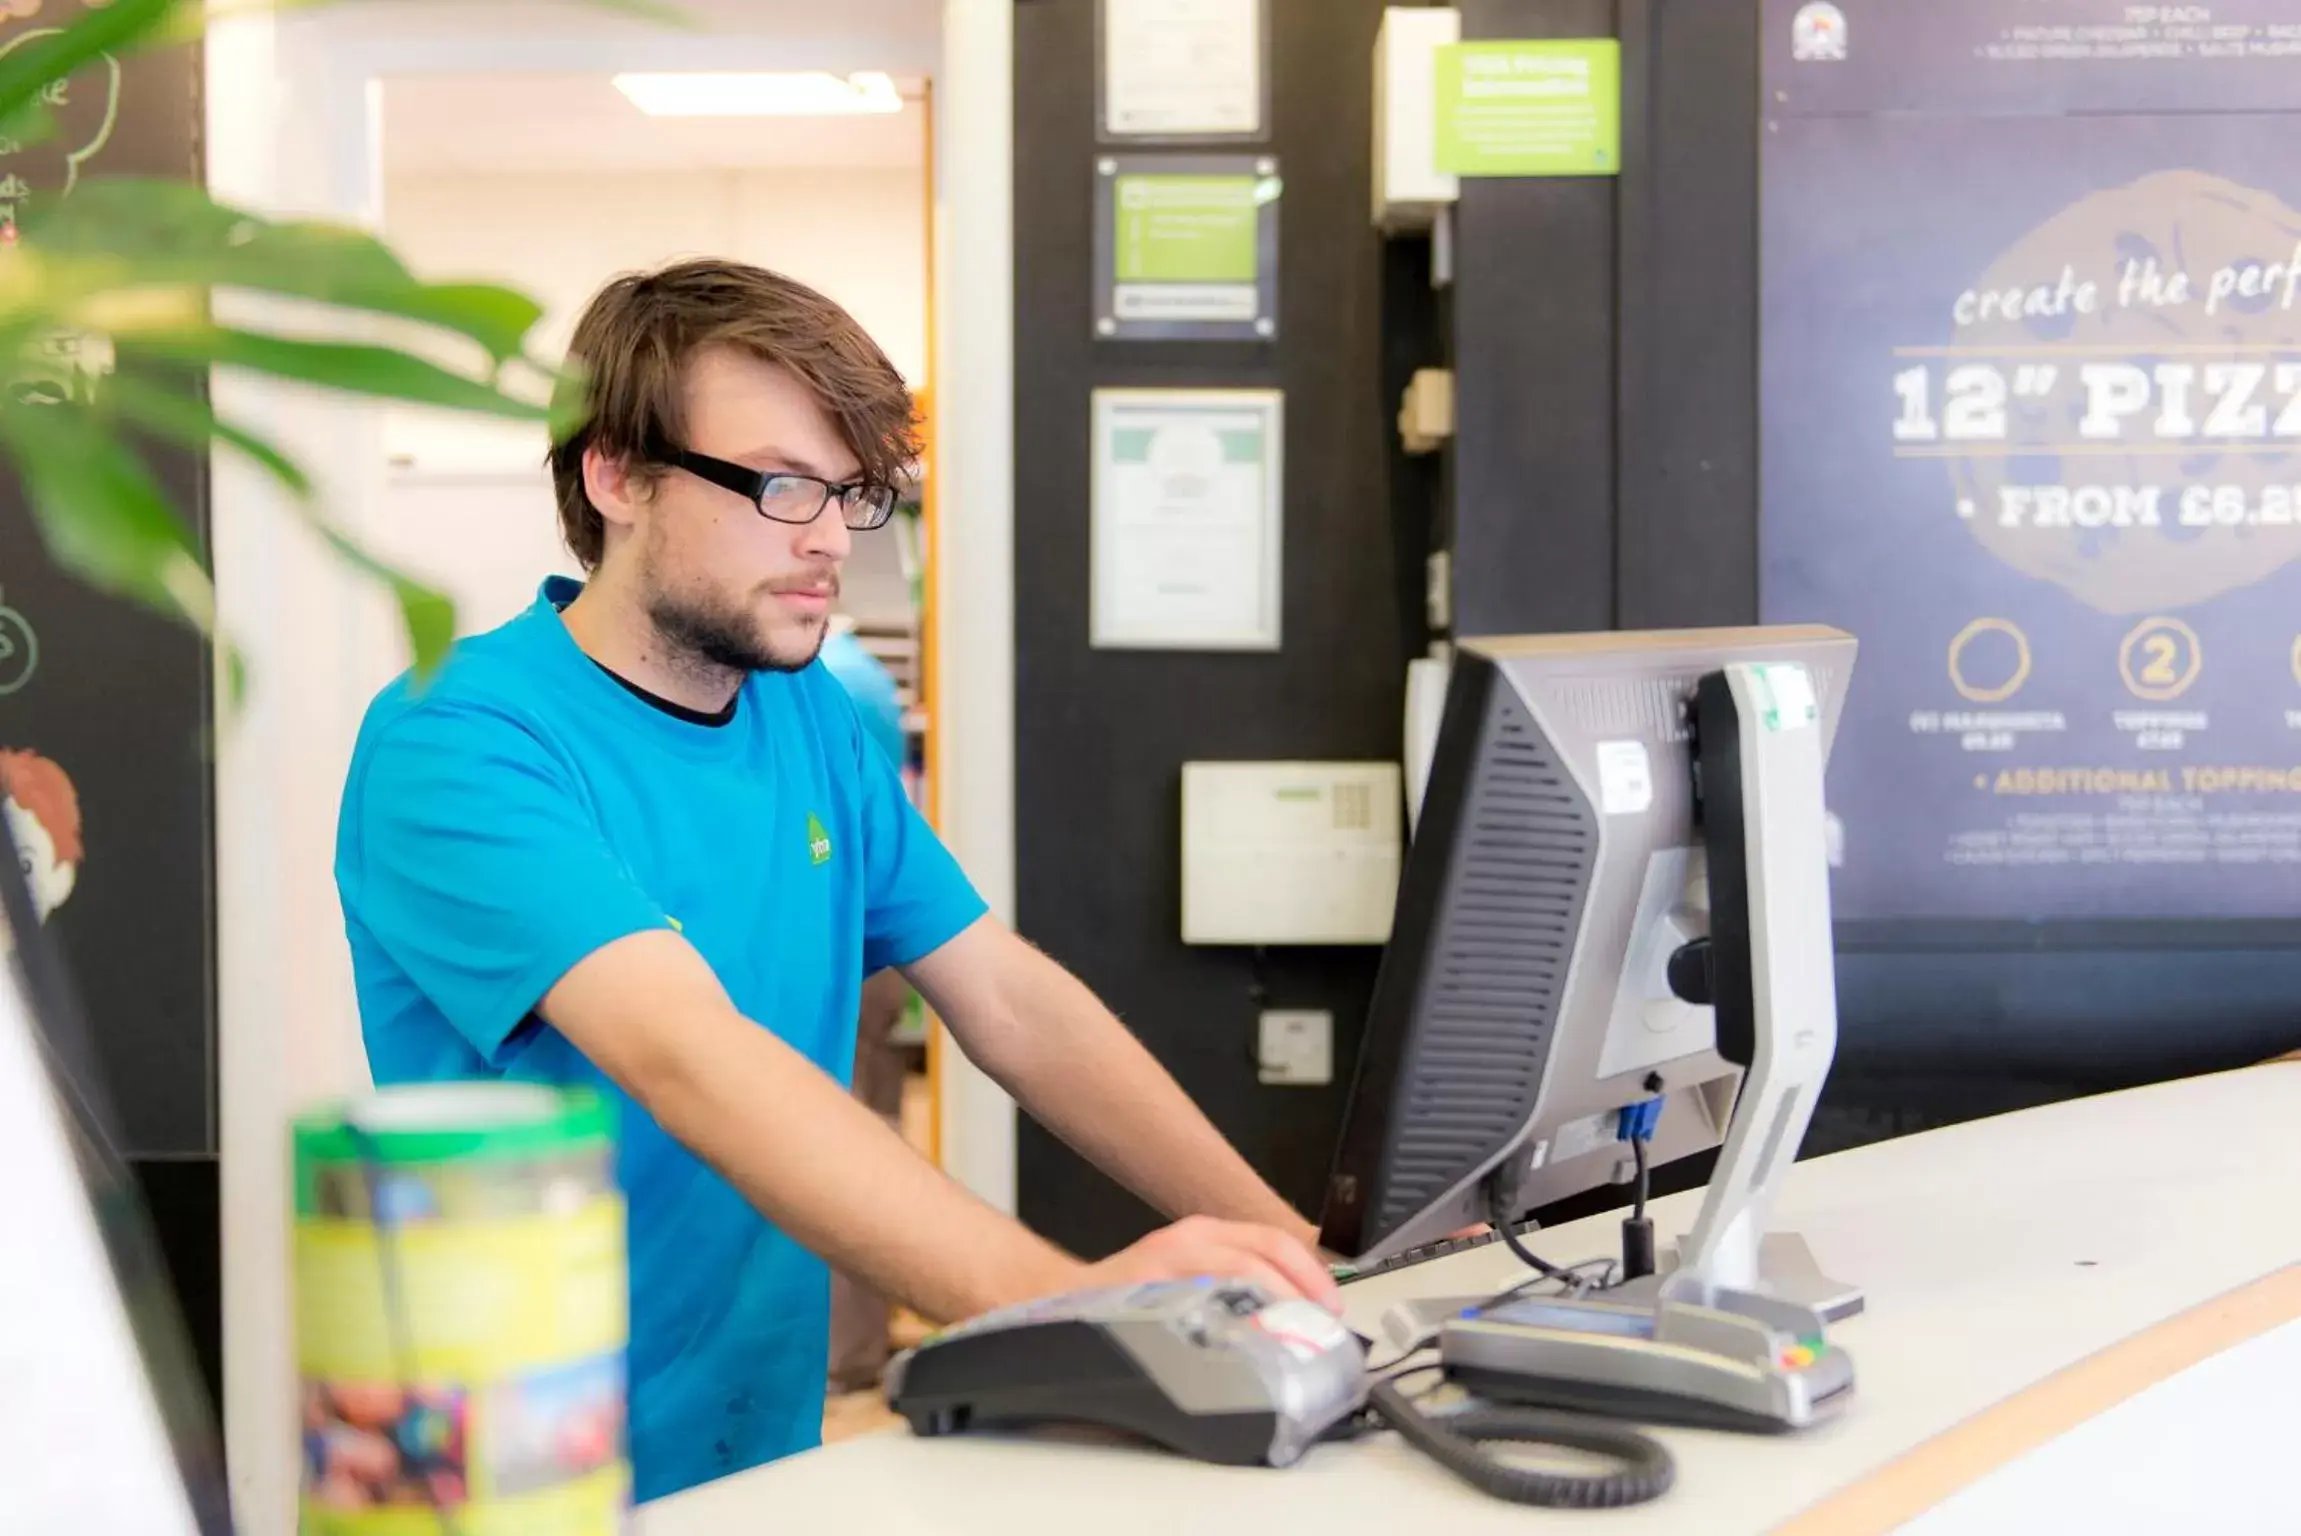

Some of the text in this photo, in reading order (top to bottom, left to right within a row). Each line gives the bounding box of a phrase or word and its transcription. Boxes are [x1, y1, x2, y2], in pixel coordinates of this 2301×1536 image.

[1952, 265, 2097, 325] create
[2118, 256, 2190, 307] the
[1893, 364, 2057, 441] 12"
[1998, 482, 2301, 527] FROM £6.2
[2140, 634, 2177, 684] 2
[1994, 767, 2171, 793] ADDITIONAL
